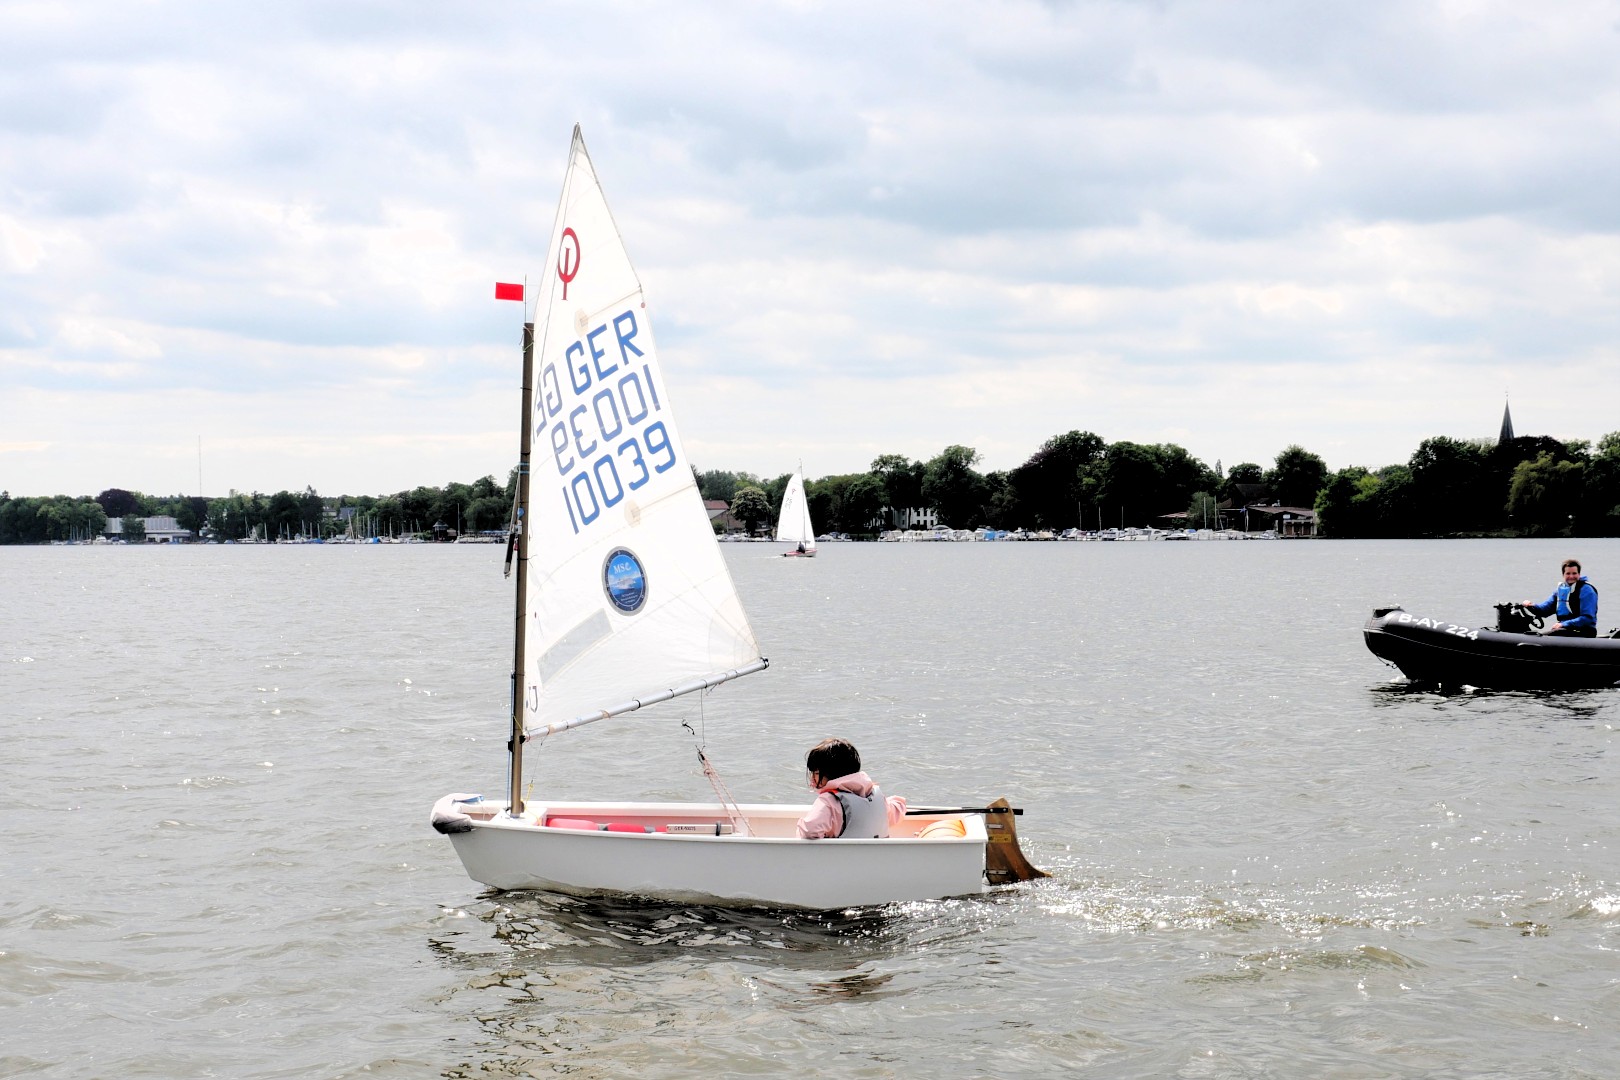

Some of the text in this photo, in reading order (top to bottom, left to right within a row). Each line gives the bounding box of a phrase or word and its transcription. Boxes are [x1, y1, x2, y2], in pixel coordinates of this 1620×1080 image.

[565, 309, 645, 396] GER
[562, 421, 676, 535] 10039
[613, 562, 632, 574] MSC
[1398, 613, 1479, 641] B-AY 224
